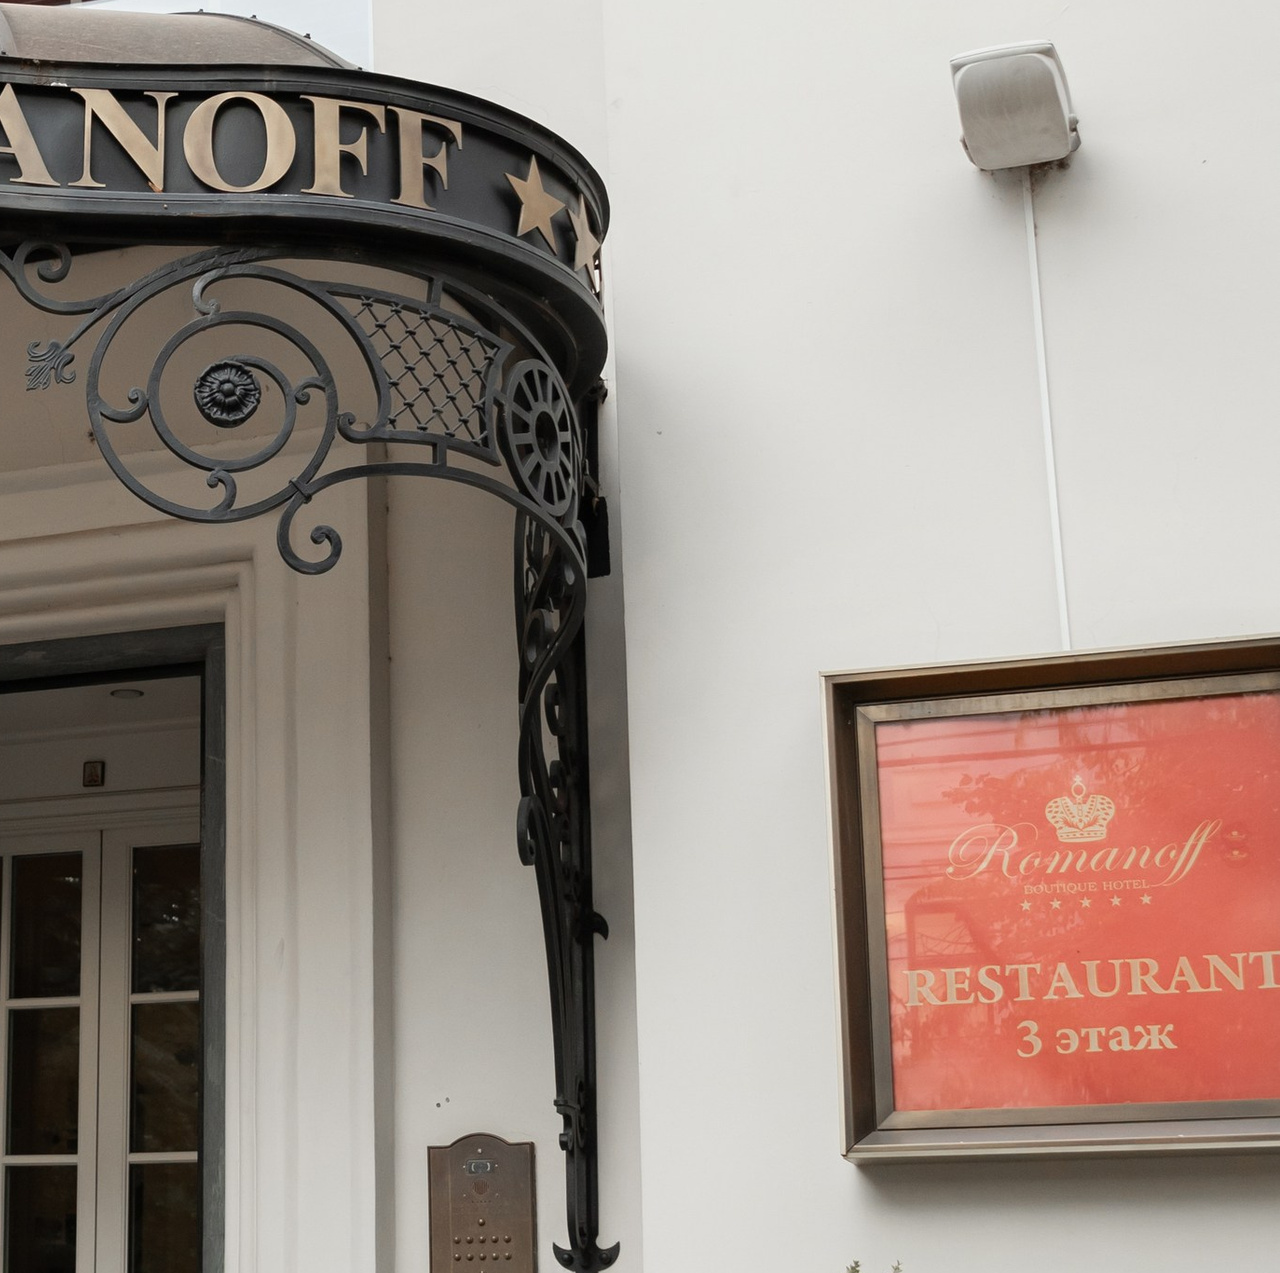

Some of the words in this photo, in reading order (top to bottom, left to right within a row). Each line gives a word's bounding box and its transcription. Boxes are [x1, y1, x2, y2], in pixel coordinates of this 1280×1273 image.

[945, 819, 1223, 887] Romanoff
[1023, 881, 1098, 895] BOUTIQUE
[1103, 879, 1150, 891] HOTEL
[902, 950, 1280, 1007] RESTAURANT
[1016, 1020, 1044, 1058] 3
[1055, 1022, 1178, 1055] этаж
